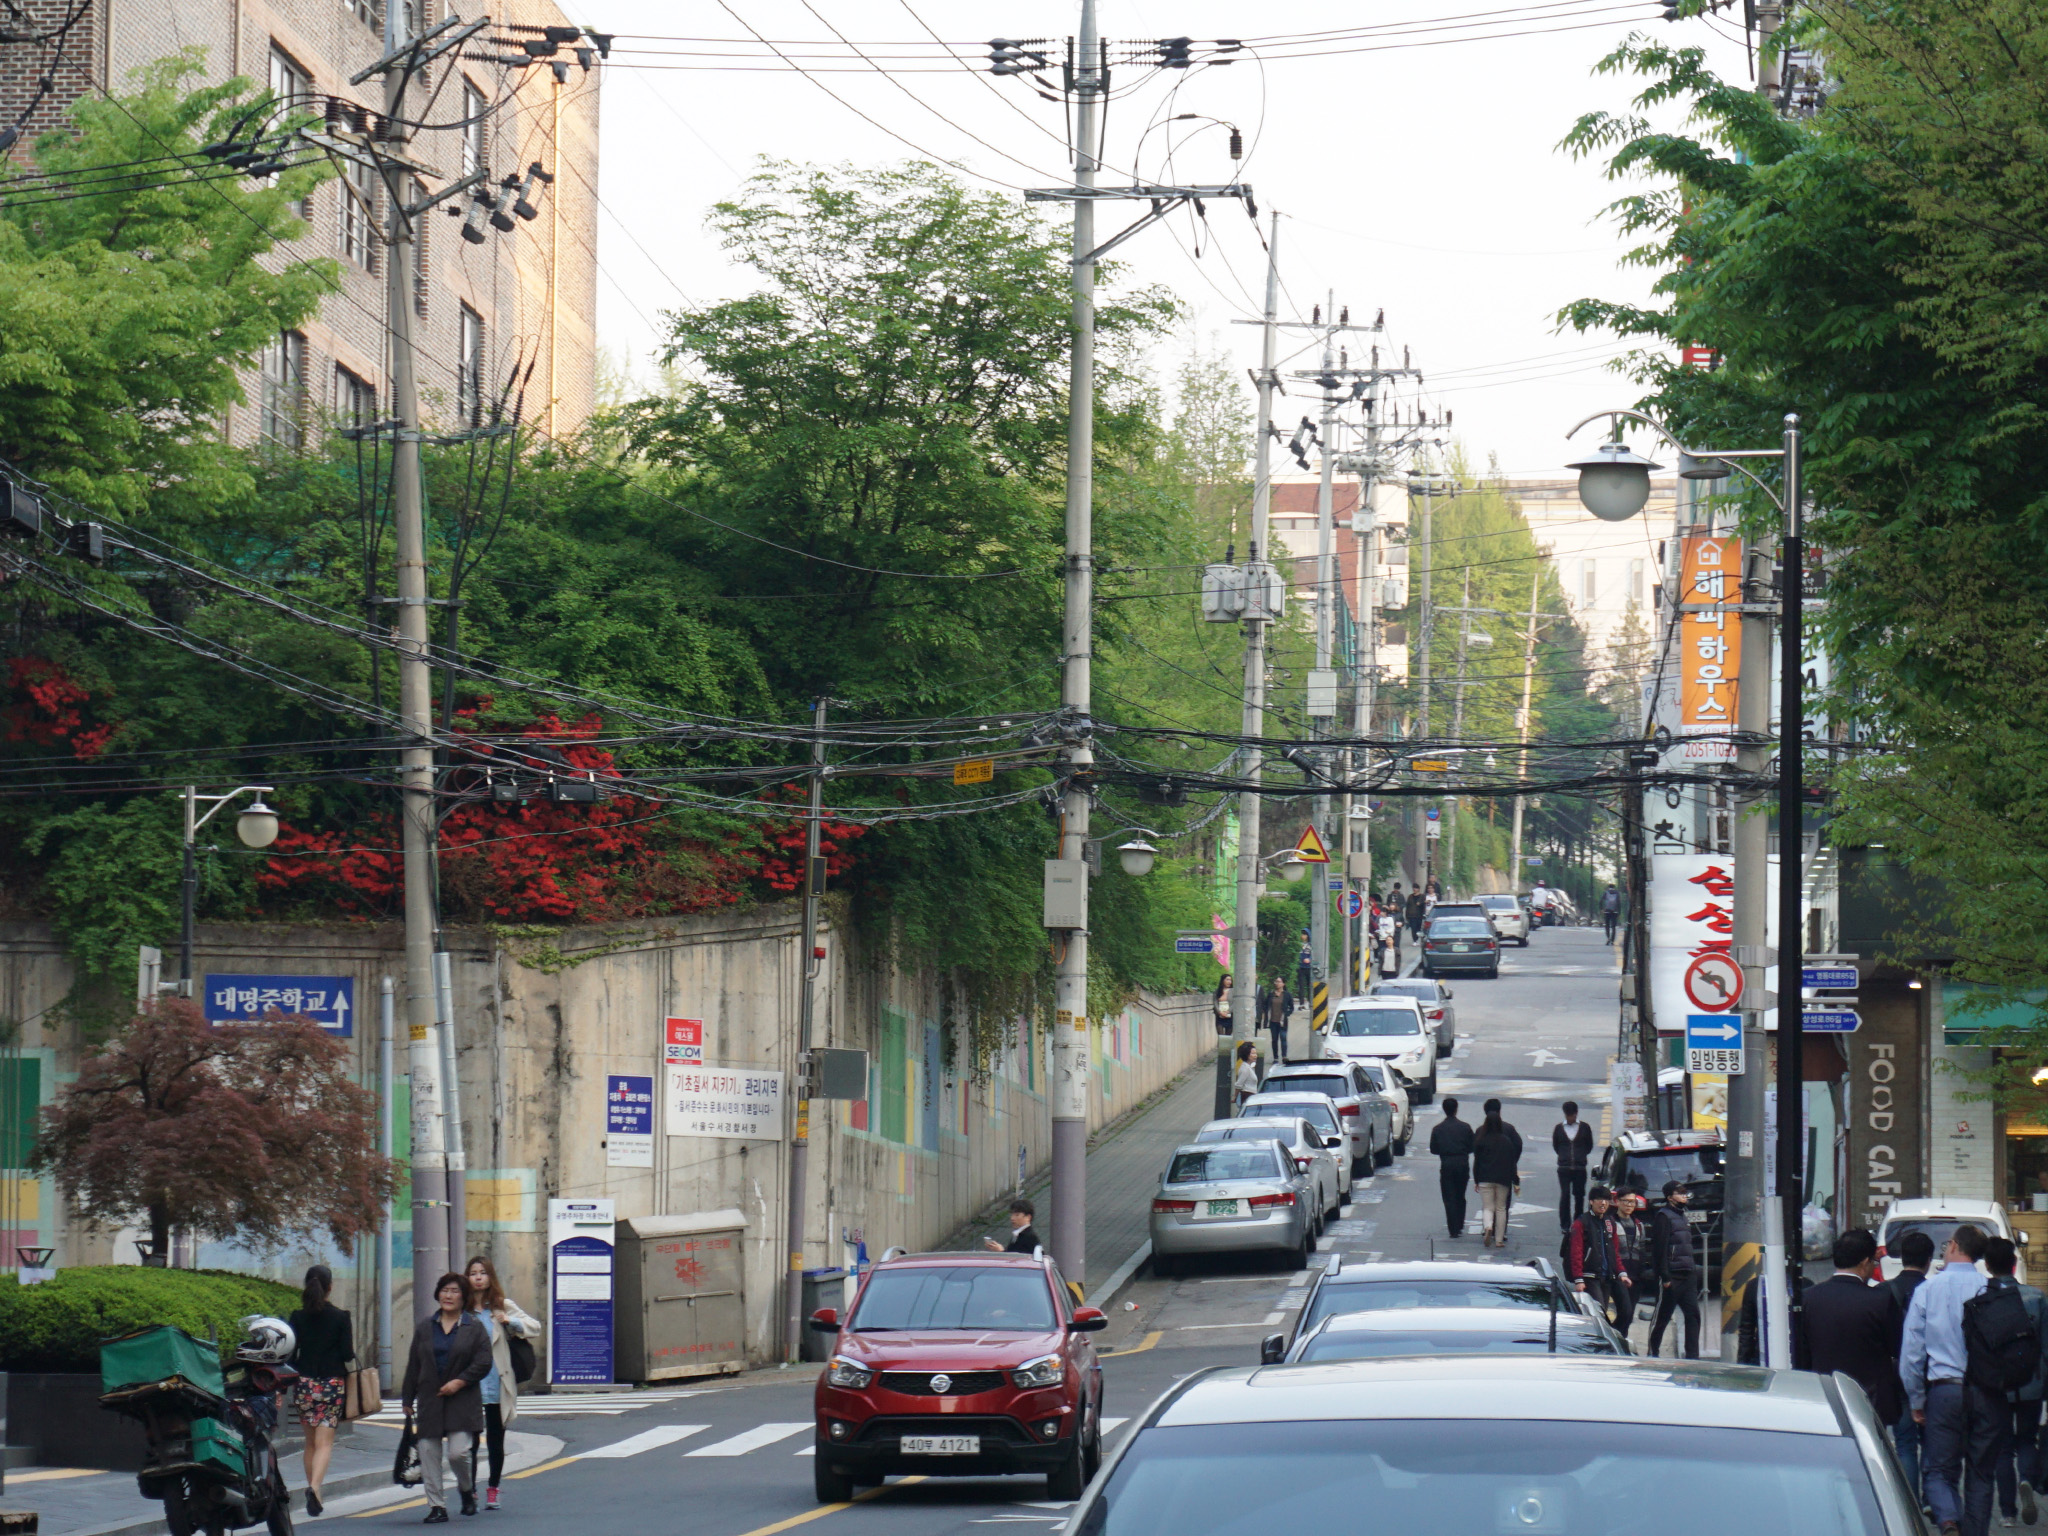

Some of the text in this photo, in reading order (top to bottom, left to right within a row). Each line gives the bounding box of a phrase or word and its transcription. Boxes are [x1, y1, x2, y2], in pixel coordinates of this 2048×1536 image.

[1694, 569, 1729, 721] 해피하우스
[213, 986, 328, 1014] 대명중학교
[667, 1046, 701, 1058] SECOM
[1691, 1050, 1740, 1072] 일방통행
[745, 1078, 778, 1098] 관리지역
[1868, 1043, 1896, 1132] FOOD
[1868, 1144, 1902, 1208] CAFE
[1210, 1205, 1237, 1215] 1229
[940, 1439, 971, 1452] 4121
